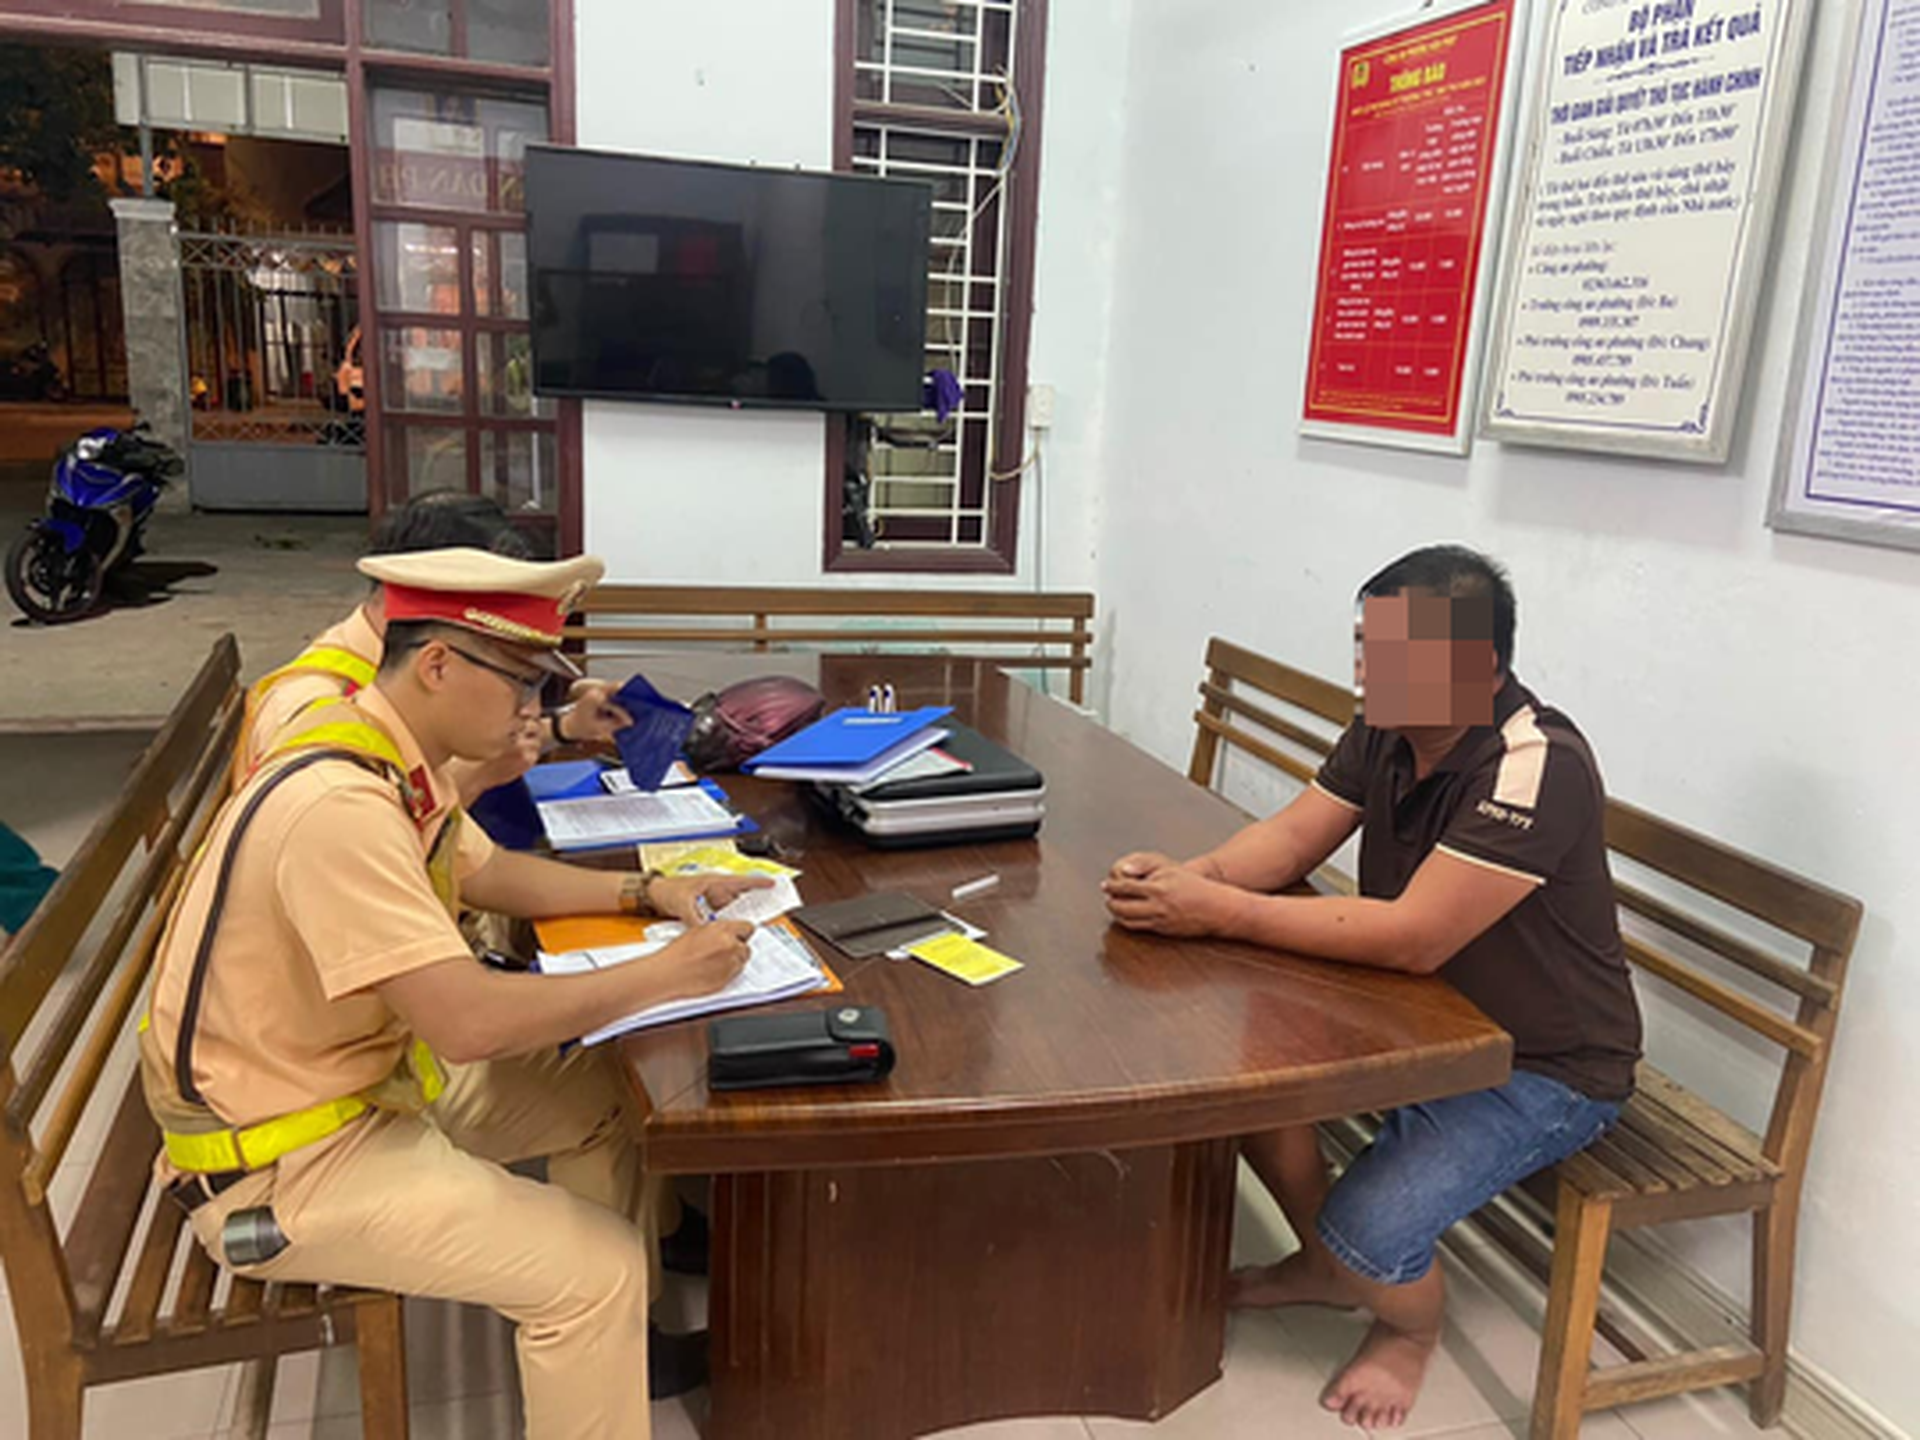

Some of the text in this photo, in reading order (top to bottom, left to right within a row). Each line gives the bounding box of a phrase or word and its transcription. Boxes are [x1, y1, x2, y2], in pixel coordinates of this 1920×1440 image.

[1564, 2, 1761, 76] TIẾP NHẬN VÀ TRẢ KẾT QUẢ
[1629, 4, 1649, 34] BỘ
